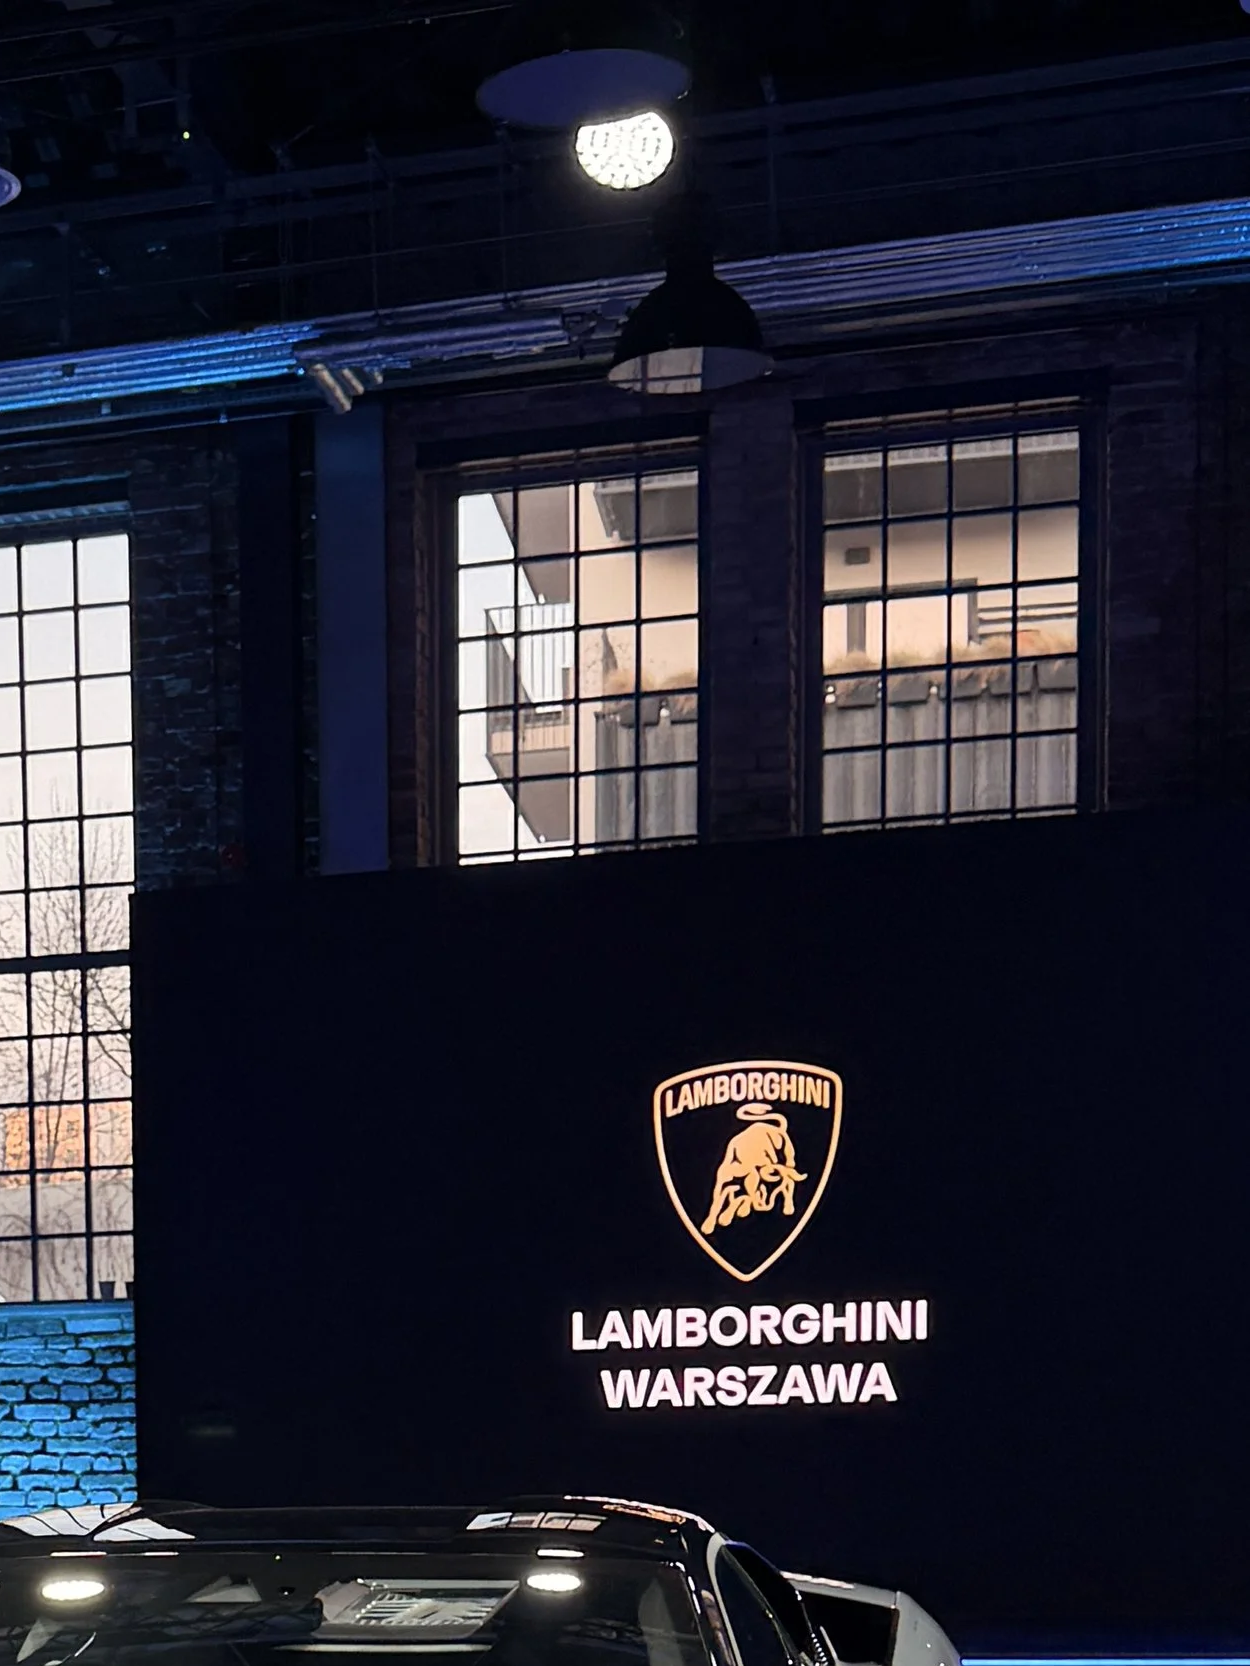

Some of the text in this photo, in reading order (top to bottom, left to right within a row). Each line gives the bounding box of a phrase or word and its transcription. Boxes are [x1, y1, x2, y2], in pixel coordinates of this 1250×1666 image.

[665, 1072, 831, 1118] LAMBORGHINI
[571, 1299, 929, 1351] LAMBORGHINI
[600, 1362, 898, 1409] WARSZAWA
